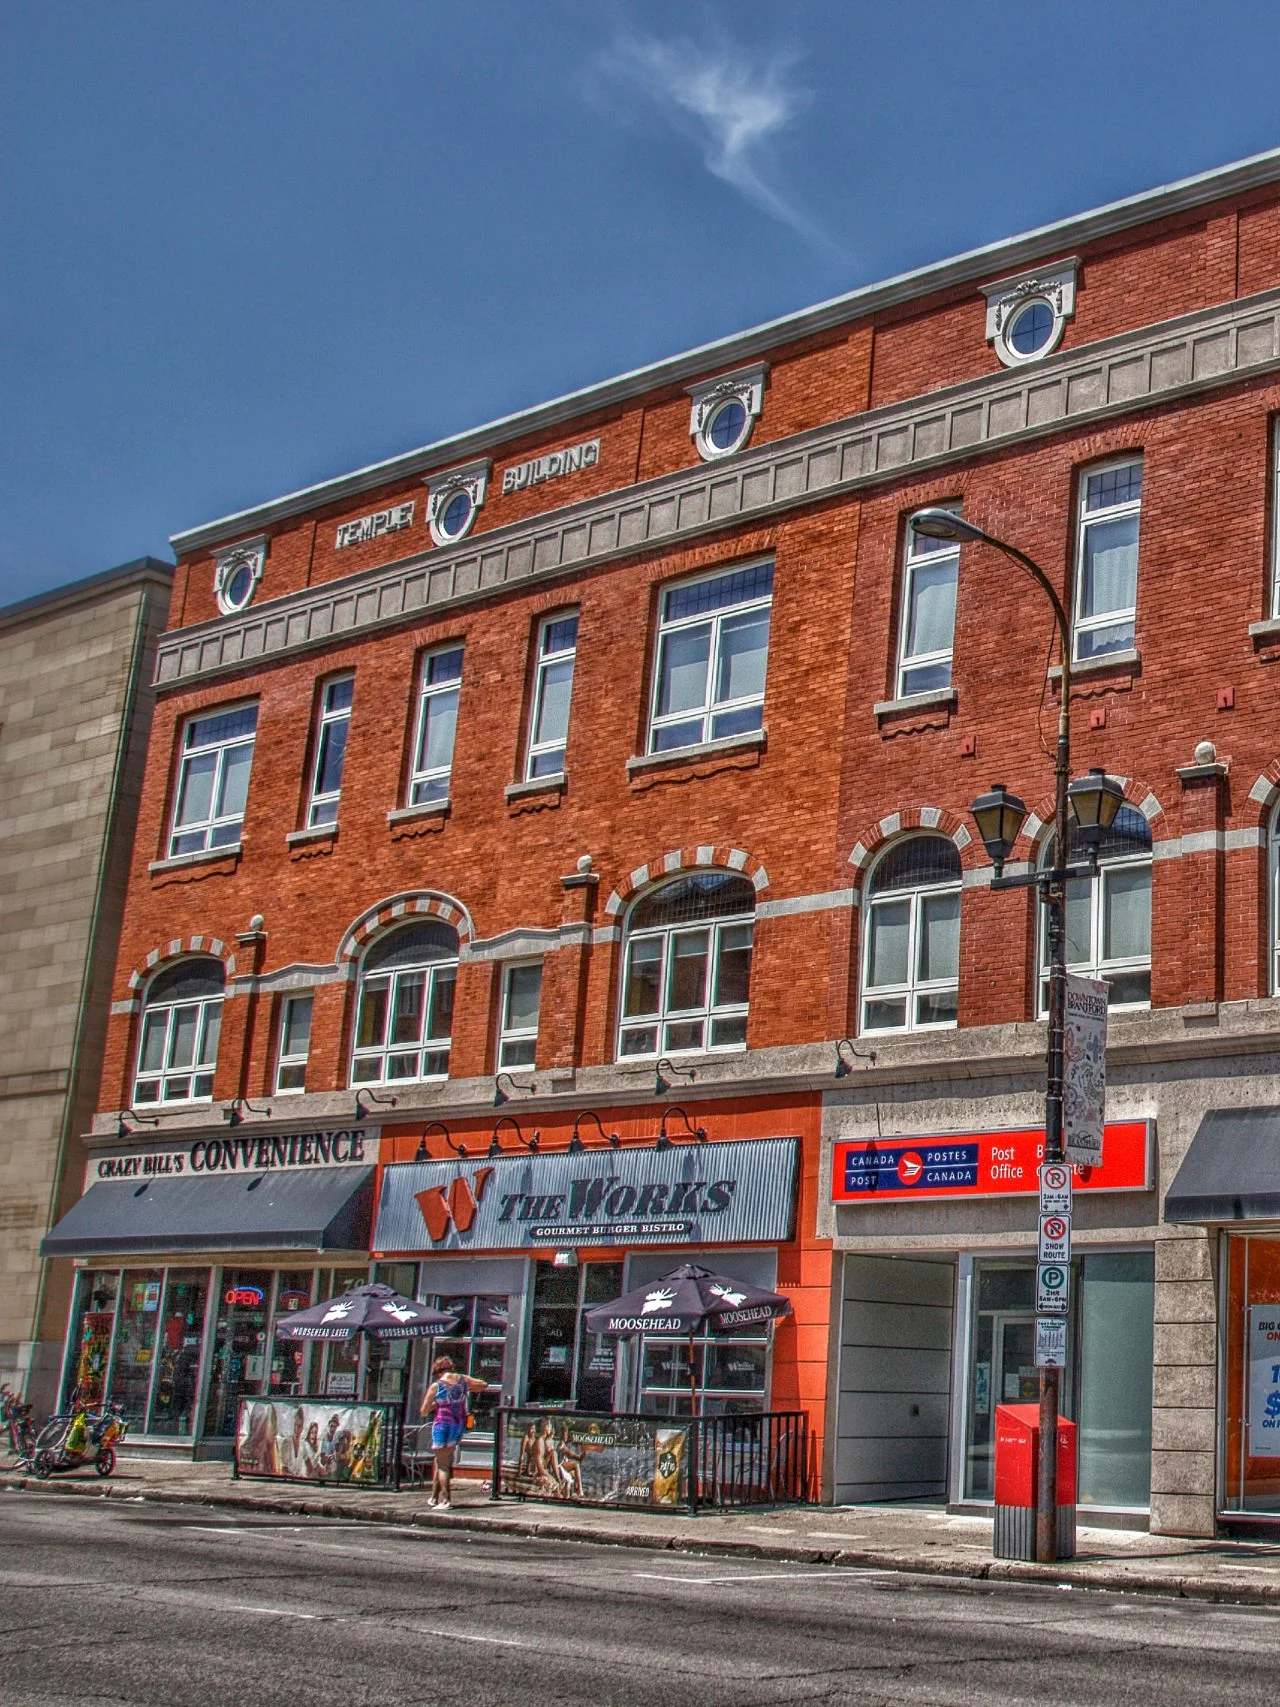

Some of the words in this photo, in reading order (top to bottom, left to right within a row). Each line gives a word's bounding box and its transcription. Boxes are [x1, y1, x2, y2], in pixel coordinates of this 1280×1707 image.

[338, 502, 413, 546] TEMPLE
[503, 441, 599, 492] BUILDING
[1067, 991, 1106, 1006] DOWNTOWN
[98, 1158, 143, 1178] CRAZY
[142, 1153, 184, 1175] BILL'S
[190, 1129, 366, 1172] CONVENIENCE
[927, 1150, 968, 1162] POSTES
[990, 1147, 1015, 1160] Post
[851, 1155, 895, 1166] CANADA
[926, 1170, 972, 1182] CANADA
[990, 1164, 1024, 1179] Office
[850, 1174, 877, 1186] POST
[414, 1166, 494, 1242] W
[498, 1193, 567, 1221] THE
[536, 1225, 590, 1237] GOURMET
[592, 1224, 639, 1235] BURGER
[641, 1222, 685, 1233] BISTRO
[1043, 1251, 1066, 1259] ROUTE
[225, 1289, 260, 1306] OPEN
[719, 1306, 772, 1324] MOOSEHEAD
[608, 1318, 681, 1330] MOOSEHEAD
[1258, 1321, 1275, 1331] BIG
[293, 1327, 330, 1337] MOOSEHEAD
[331, 1328, 349, 1338] LAGER
[379, 1326, 419, 1337] MOOSEHEAD
[1262, 1420, 1277, 1429] ON
[572, 1433, 615, 1445] MOOSEHEAD
